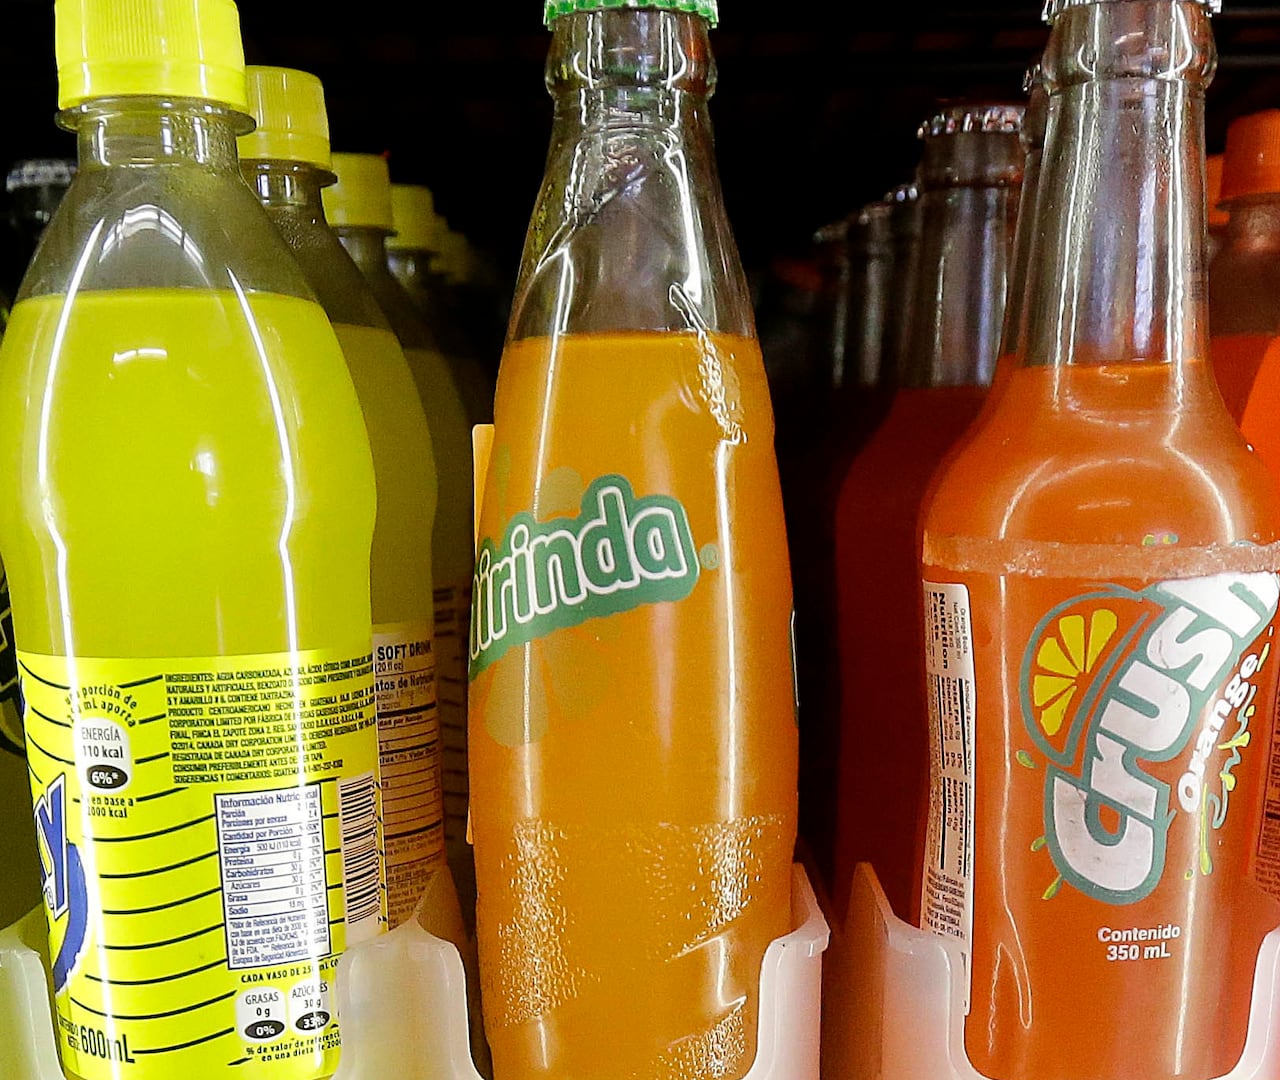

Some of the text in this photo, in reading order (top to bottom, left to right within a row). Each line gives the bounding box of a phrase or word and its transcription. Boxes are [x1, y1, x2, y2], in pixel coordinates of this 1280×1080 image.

[470, 486, 688, 660] irinda
[377, 644, 407, 662] SOFT
[82, 684, 138, 710] porción de
[84, 697, 136, 728] mL aporta
[81, 726, 121, 742] ENERGÍA
[222, 726, 247, 736] ZAPOTE
[1177, 652, 1258, 814] Orange
[101, 745, 124, 759] kcal
[103, 796, 126, 807] base
[220, 794, 274, 809] Información
[108, 807, 128, 818] kcal
[221, 809, 246, 819] Porción
[222, 817, 254, 829] Porciones
[222, 830, 254, 841] Cantidad
[268, 826, 294, 837] Porción
[224, 844, 250, 856] Energía
[228, 906, 249, 916] Sodio
[1097, 924, 1181, 944] Contenido
[1106, 939, 1172, 961] 350 mL
[240, 968, 302, 984] CADA VASO DE
[291, 981, 328, 999] AZÚCAES
[244, 991, 280, 1005] GRASAS
[255, 1025, 276, 1037] 0%
[269, 1041, 293, 1052] valor
[274, 1052, 291, 1062] una
[292, 1046, 314, 1059] dieta
